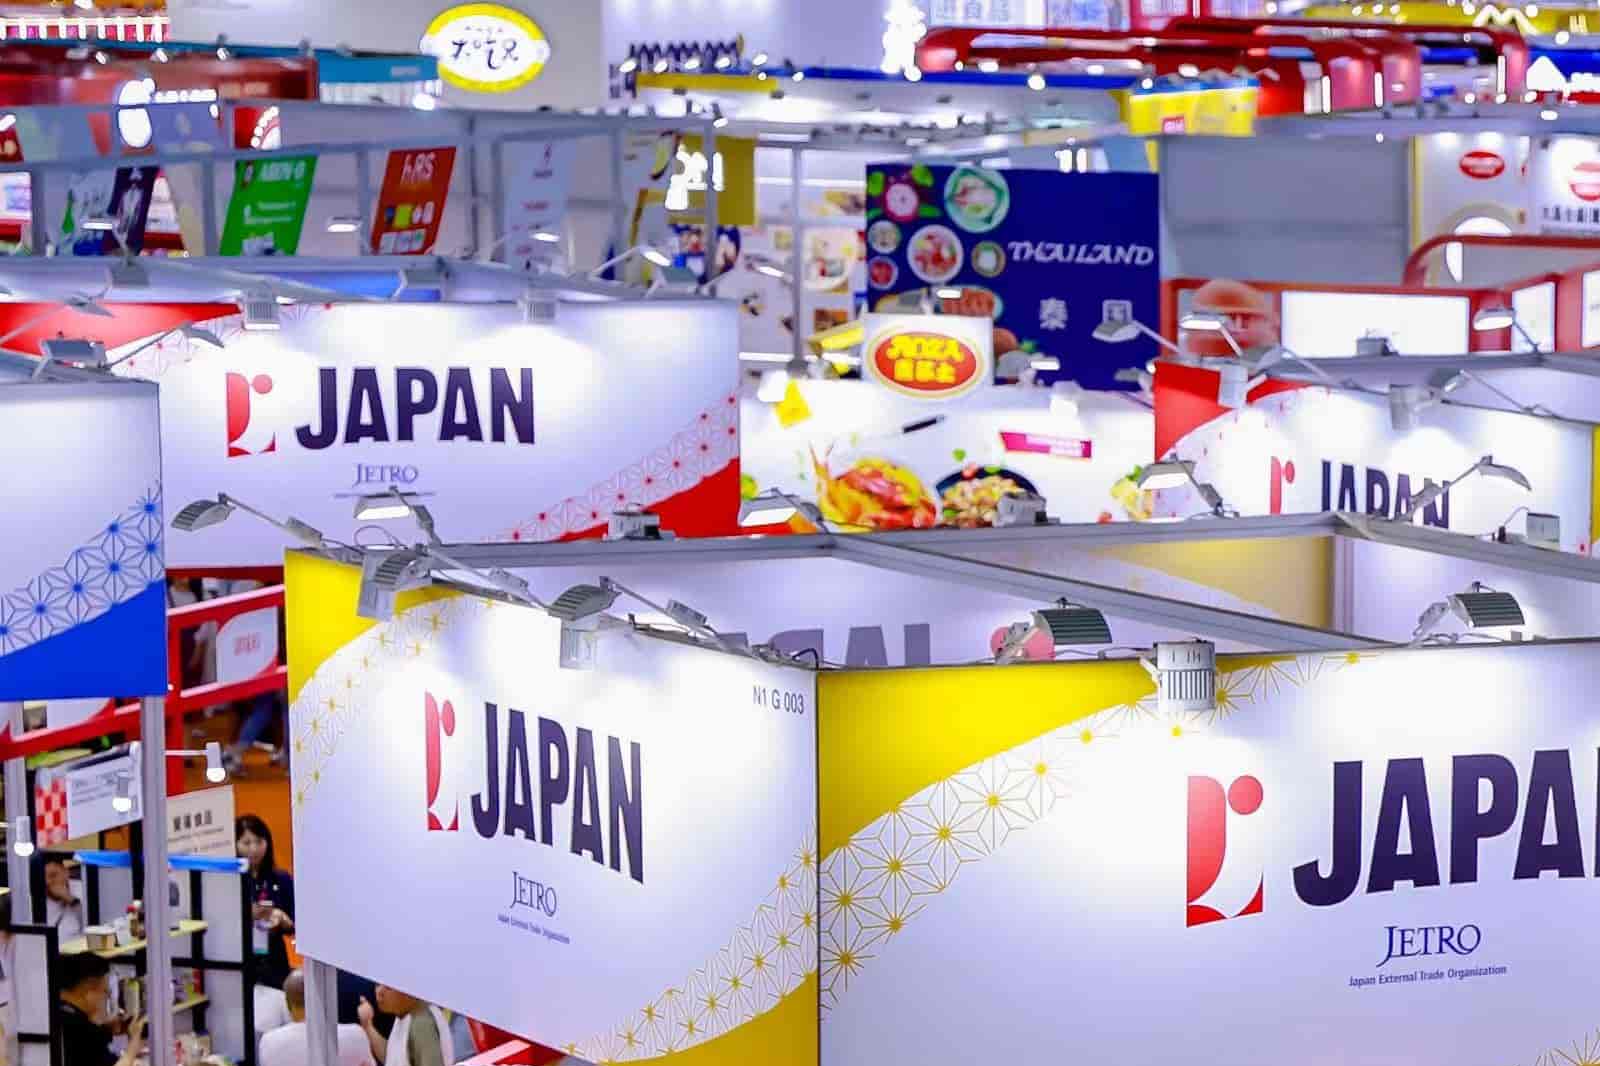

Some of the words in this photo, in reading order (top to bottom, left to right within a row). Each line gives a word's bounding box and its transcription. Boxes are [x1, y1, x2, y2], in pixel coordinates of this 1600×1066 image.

[1007, 241, 1154, 265] THAILAND
[295, 366, 536, 450] JAPAN
[351, 463, 419, 486] JETRO
[1321, 459, 1450, 529] JAPAN
[753, 685, 767, 707] N1
[772, 690, 781, 710] G
[784, 690, 805, 714] 003
[471, 701, 644, 885] JAPAN
[510, 871, 557, 917] JETRO
[1375, 924, 1482, 968] JETRO
[1349, 975, 1376, 989] Japan
[1378, 970, 1417, 985] External
[1420, 969, 1444, 982] Trade
[1447, 965, 1507, 981] Organization
